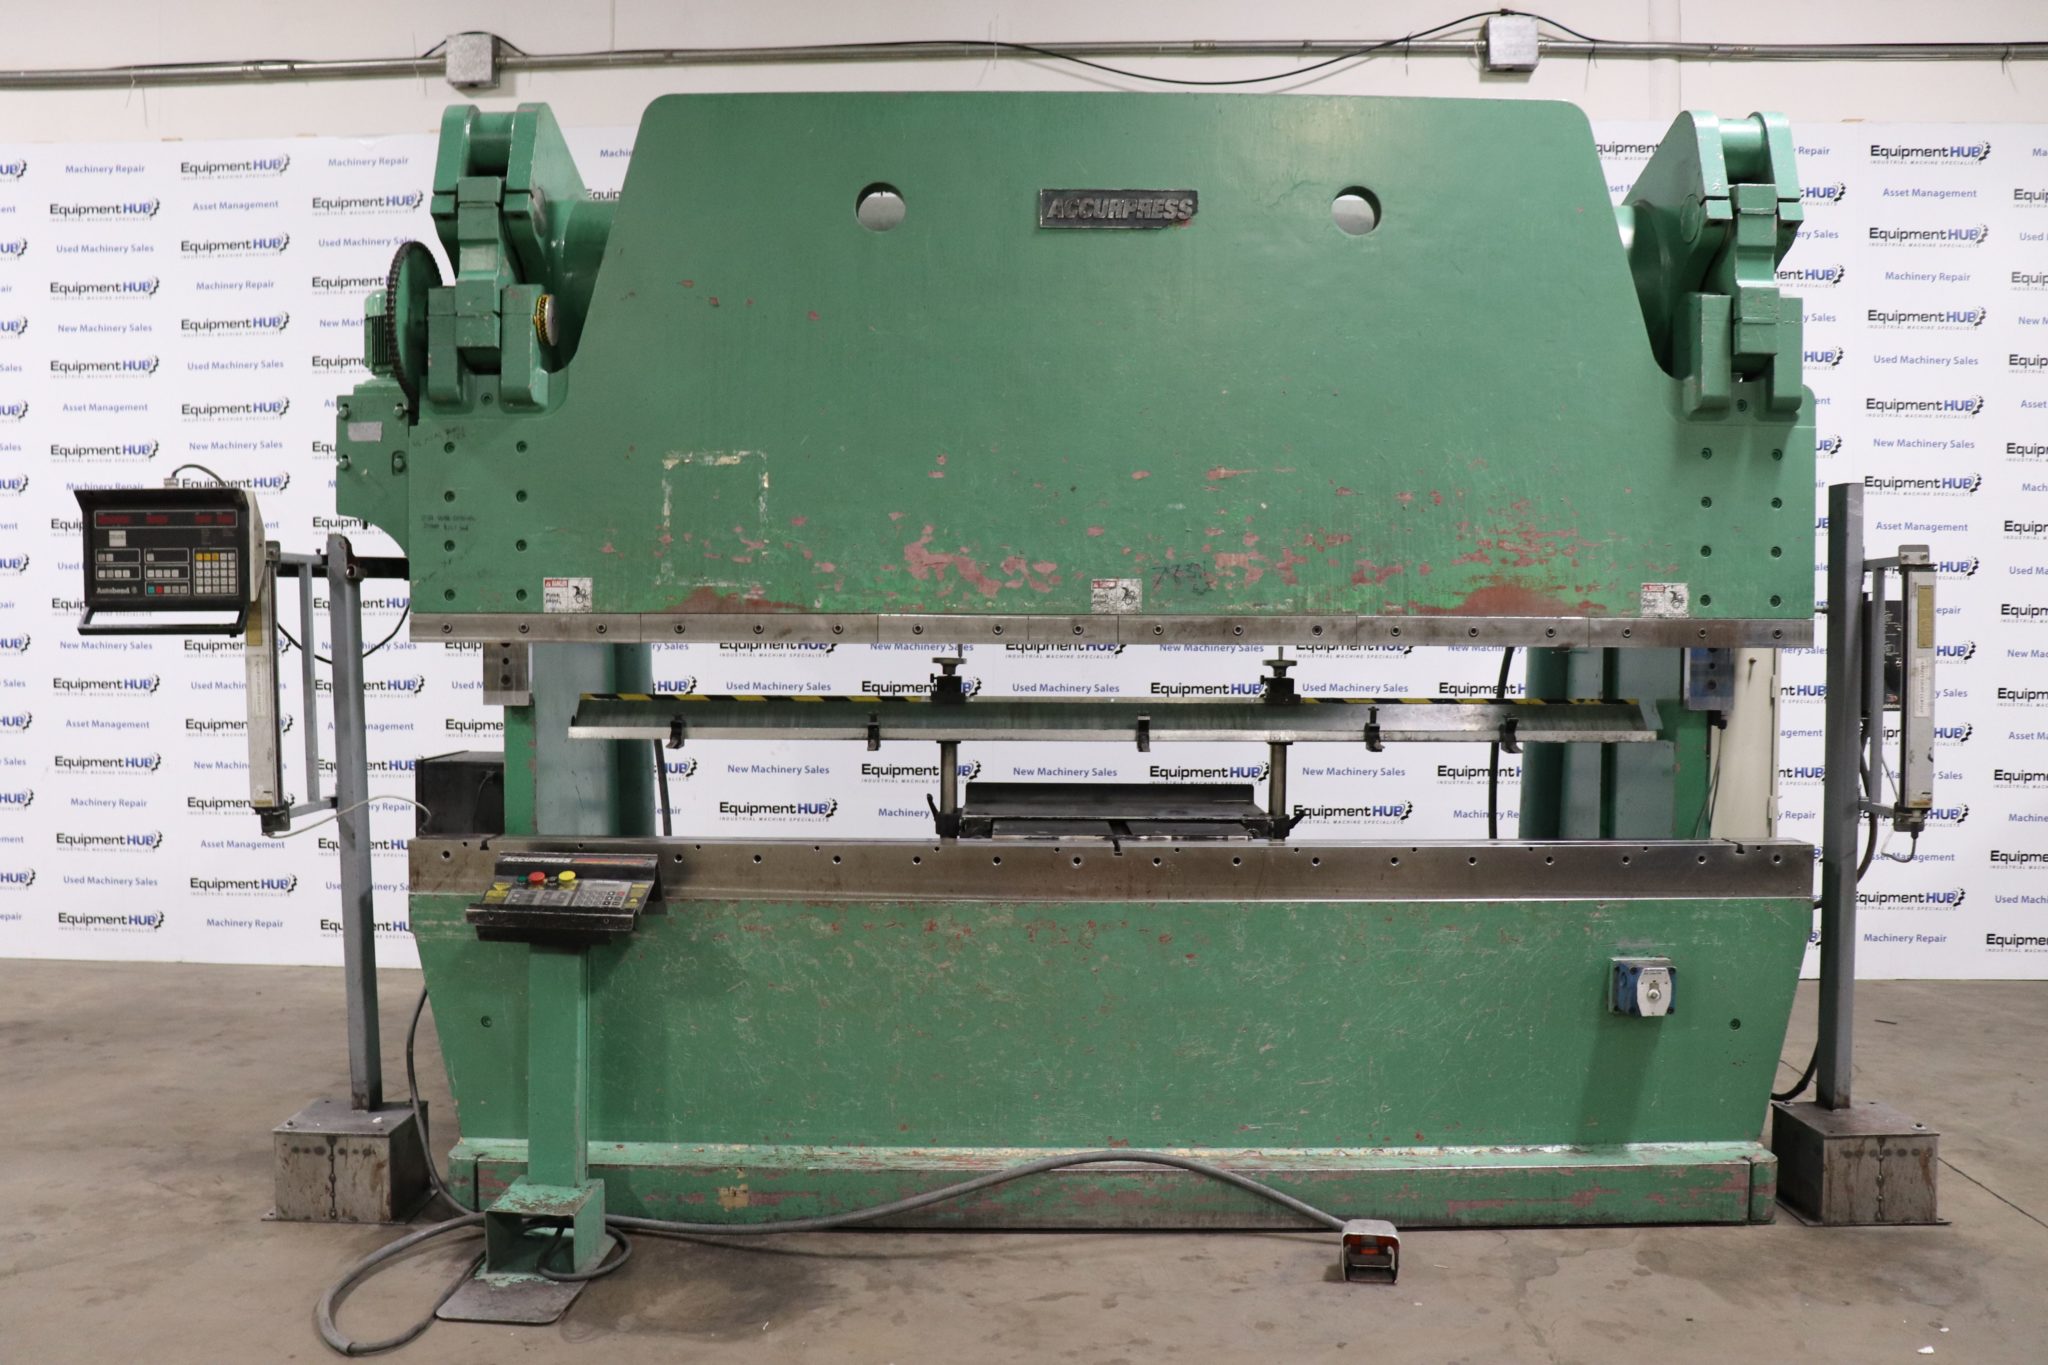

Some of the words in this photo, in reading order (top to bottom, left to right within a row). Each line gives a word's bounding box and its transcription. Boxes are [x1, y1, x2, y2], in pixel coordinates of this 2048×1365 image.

[1798, 146, 1831, 156] Repair
[1871, 145, 1949, 160] Equipment
[1949, 147, 1979, 157] HUB
[181, 161, 252, 175] Equipment
[252, 160, 279, 172] HUB
[328, 158, 377, 168] Machinery
[379, 156, 409, 167] Repair
[66, 165, 114, 175] Machinery
[116, 165, 145, 174] Repair
[1883, 188, 1910, 197] Asset
[1912, 189, 1977, 199] Management
[219, 200, 279, 211] Management
[312, 196, 384, 211] Equipment
[385, 195, 413, 207] HUB
[50, 204, 121, 217] Equipment
[122, 203, 150, 215] HUB
[1047, 199, 1193, 220] ACCURPRESS
[1814, 230, 1839, 239] Sales
[1869, 228, 1946, 242] Equipment
[1947, 228, 1977, 241] HUB
[2019, 232, 2043, 241] Used
[181, 239, 252, 254] Equipment
[252, 239, 281, 250] HUB
[343, 238, 391, 247] Machinery
[57, 245, 79, 253] Used
[81, 244, 129, 254] Machinery
[131, 244, 155, 252] Sales
[312, 276, 384, 289] Equipment
[1885, 272, 1937, 283] Machinery
[1939, 273, 1971, 283] Repair
[50, 283, 121, 296] Equipment
[122, 282, 150, 292] HUB
[196, 282, 244, 291] Machinery
[246, 280, 275, 290] Repair
[1811, 313, 1836, 322] Sales
[1868, 310, 1945, 325] Equipment
[1945, 312, 1975, 323] HUB
[2018, 316, 2041, 325] New
[58, 324, 78, 333] New
[80, 324, 128, 333] Machinery
[130, 323, 153, 332] Sales
[181, 318, 251, 333] Equipment
[252, 318, 279, 328] HUB
[188, 362, 210, 370] Used
[212, 361, 259, 370] Machinery
[261, 360, 285, 368] Sales
[1874, 355, 1898, 363] Used
[1900, 355, 1952, 367] Machinery
[1954, 356, 1979, 365] Sales
[50, 361, 121, 374] Equipment
[121, 360, 149, 371] HUB
[63, 403, 87, 412] Asset
[89, 403, 149, 413] Management
[182, 402, 252, 417] Equipment
[252, 402, 280, 413] HUB
[1866, 398, 1943, 413] Equipment
[1943, 400, 1974, 412] HUB
[2020, 400, 2047, 409] Asset
[189, 442, 209, 450] New
[211, 441, 258, 450] Machinery
[260, 440, 284, 448] Sales
[1874, 439, 1895, 447] New
[1897, 439, 1949, 450] Machinery
[1950, 440, 1976, 448] Sales
[51, 445, 121, 458] Equipment
[122, 444, 148, 455] HUB
[253, 477, 281, 490] HUB
[1864, 476, 1940, 491] Equipment
[1941, 478, 1972, 489] HUB
[1876, 522, 1903, 530] Asset
[1904, 522, 1969, 533] Management
[57, 562, 79, 570] Used
[2009, 566, 2032, 575] Used
[60, 641, 80, 649] New
[81, 641, 128, 651] Machinery
[130, 641, 153, 650] Sales
[393, 641, 416, 650] Sales
[894, 643, 945, 652] Machinery
[1183, 644, 1235, 653] Machinery
[2007, 649, 2028, 658] New
[53, 678, 123, 692] Equipment
[123, 678, 150, 689] HUB
[191, 682, 213, 690] Used
[387, 680, 415, 691] HUB
[657, 680, 687, 692] HUB
[727, 682, 751, 690] Used
[753, 682, 804, 692] Machinery
[806, 682, 832, 691] Sales
[1013, 683, 1037, 692] Used
[1039, 684, 1092, 694] Machinery
[1094, 684, 1120, 692] Sales
[1150, 682, 1229, 697] Equipment
[1230, 683, 1261, 695] HUB
[1302, 683, 1327, 692] Used
[1329, 683, 1382, 694] Machinery
[1384, 684, 1409, 692] Sales
[1942, 688, 1968, 698] Sales
[66, 720, 90, 728] Asset
[92, 720, 150, 730] Management
[2008, 731, 2033, 740] Asset
[55, 756, 124, 770] Equipment
[124, 756, 152, 767] HUB
[193, 761, 213, 769] New
[388, 760, 416, 771] HUB
[728, 765, 749, 773] New
[751, 765, 803, 776] Machinery
[805, 765, 830, 774] Sales
[861, 763, 939, 778] Equipment
[1013, 767, 1035, 775] New
[1037, 768, 1090, 778] Machinery
[1092, 768, 1118, 776] Sales
[1149, 765, 1228, 780] Equipment
[1229, 767, 1260, 778] HUB
[1303, 767, 1325, 775] New
[1326, 767, 1378, 778] Machinery
[1381, 768, 1406, 776] Sales
[1938, 771, 1963, 780] Sales
[71, 798, 117, 808] Machinery
[119, 799, 147, 808] Repair
[382, 802, 411, 811] Repair
[720, 802, 796, 817] Equipment
[796, 804, 827, 814] HUB
[878, 808, 930, 820] Machinery
[1785, 811, 1816, 821] Repair
[56, 833, 125, 847] Equipment
[126, 833, 152, 847] HUB
[201, 840, 225, 848] Asset
[227, 840, 286, 850] Management
[64, 876, 86, 884] Used
[87, 876, 134, 887] Machinery
[135, 877, 158, 886] Sales
[190, 878, 260, 892] Equipment
[260, 879, 287, 890] HUB
[1994, 895, 2018, 904] Used
[58, 913, 127, 926] Equipment
[127, 914, 155, 926] HUB
[207, 918, 253, 928] Machinery
[255, 919, 284, 929] Repair
[1864, 934, 1915, 944] Machinery
[1916, 934, 1948, 944] Repair
